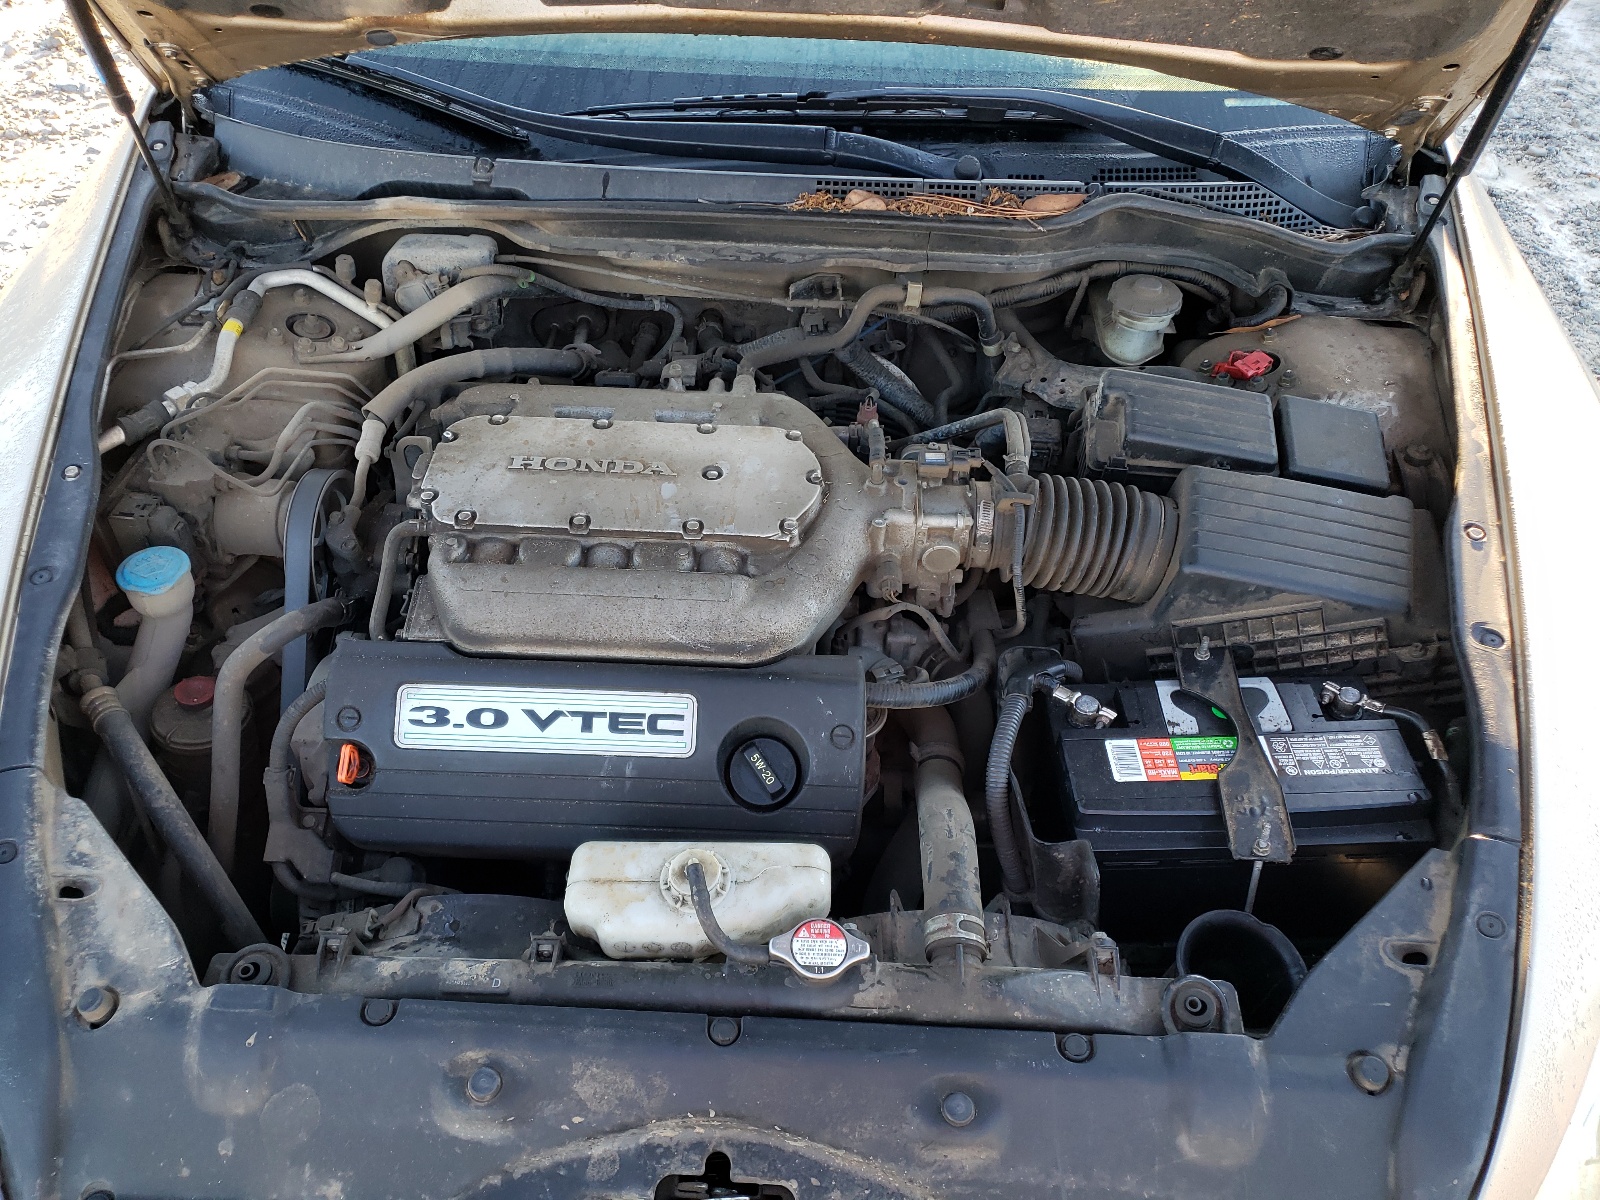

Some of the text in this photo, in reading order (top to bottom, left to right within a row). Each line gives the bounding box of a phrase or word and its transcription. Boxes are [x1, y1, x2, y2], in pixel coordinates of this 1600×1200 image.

[507, 455, 678, 477] HONDA
[407, 705, 685, 737] 3.0 VTEC
[750, 753, 775, 785] 5W-20
[491, 978, 502, 988] D
